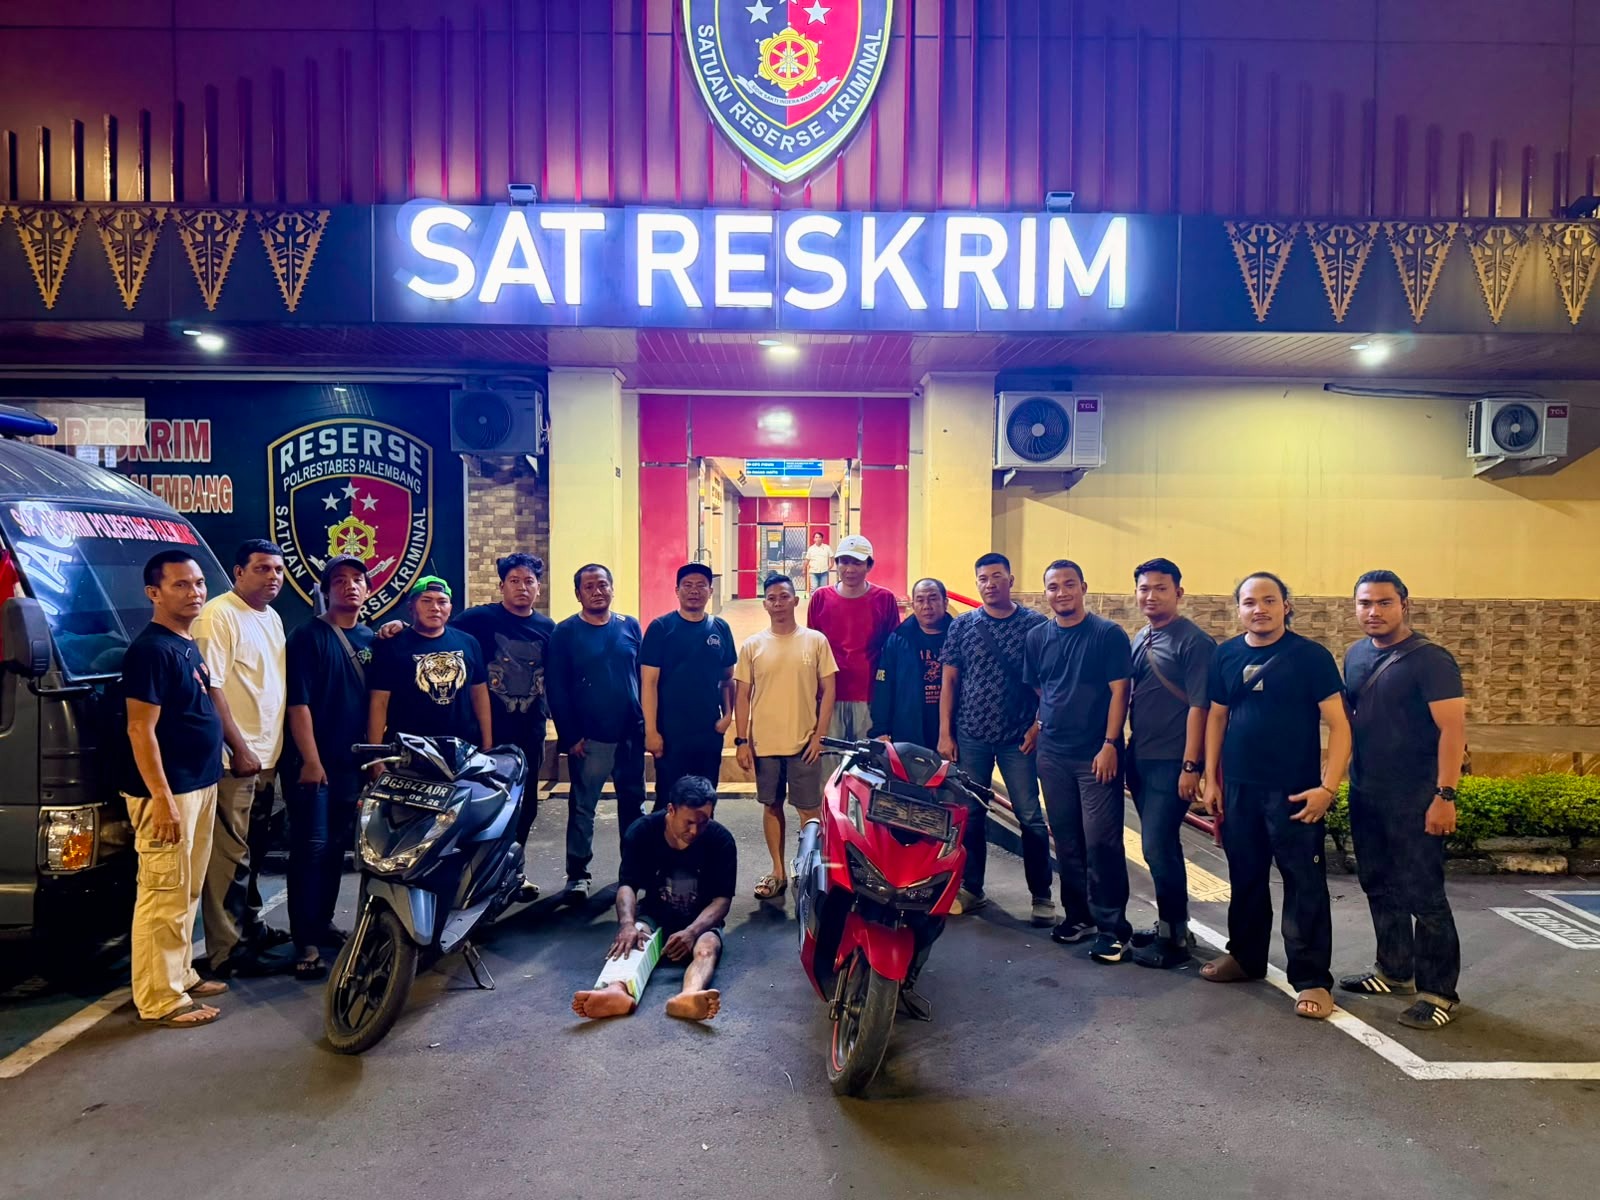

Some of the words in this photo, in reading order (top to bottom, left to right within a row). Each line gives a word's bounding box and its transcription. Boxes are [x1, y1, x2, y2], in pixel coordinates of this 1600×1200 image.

[697, 24, 733, 104] SATUAN
[729, 101, 826, 153] RESERSE
[825, 28, 882, 124] KRIMINAL
[407, 204, 606, 306] SAT
[636, 214, 1128, 310] RESKRIM
[280, 427, 423, 477] RESERSE
[283, 458, 356, 492] POLRESTABES
[358, 462, 422, 494] PALEMBANG
[120, 474, 234, 514] EMBANG
[275, 505, 307, 580] SATUAN
[393, 507, 427, 592] KRIMINAL
